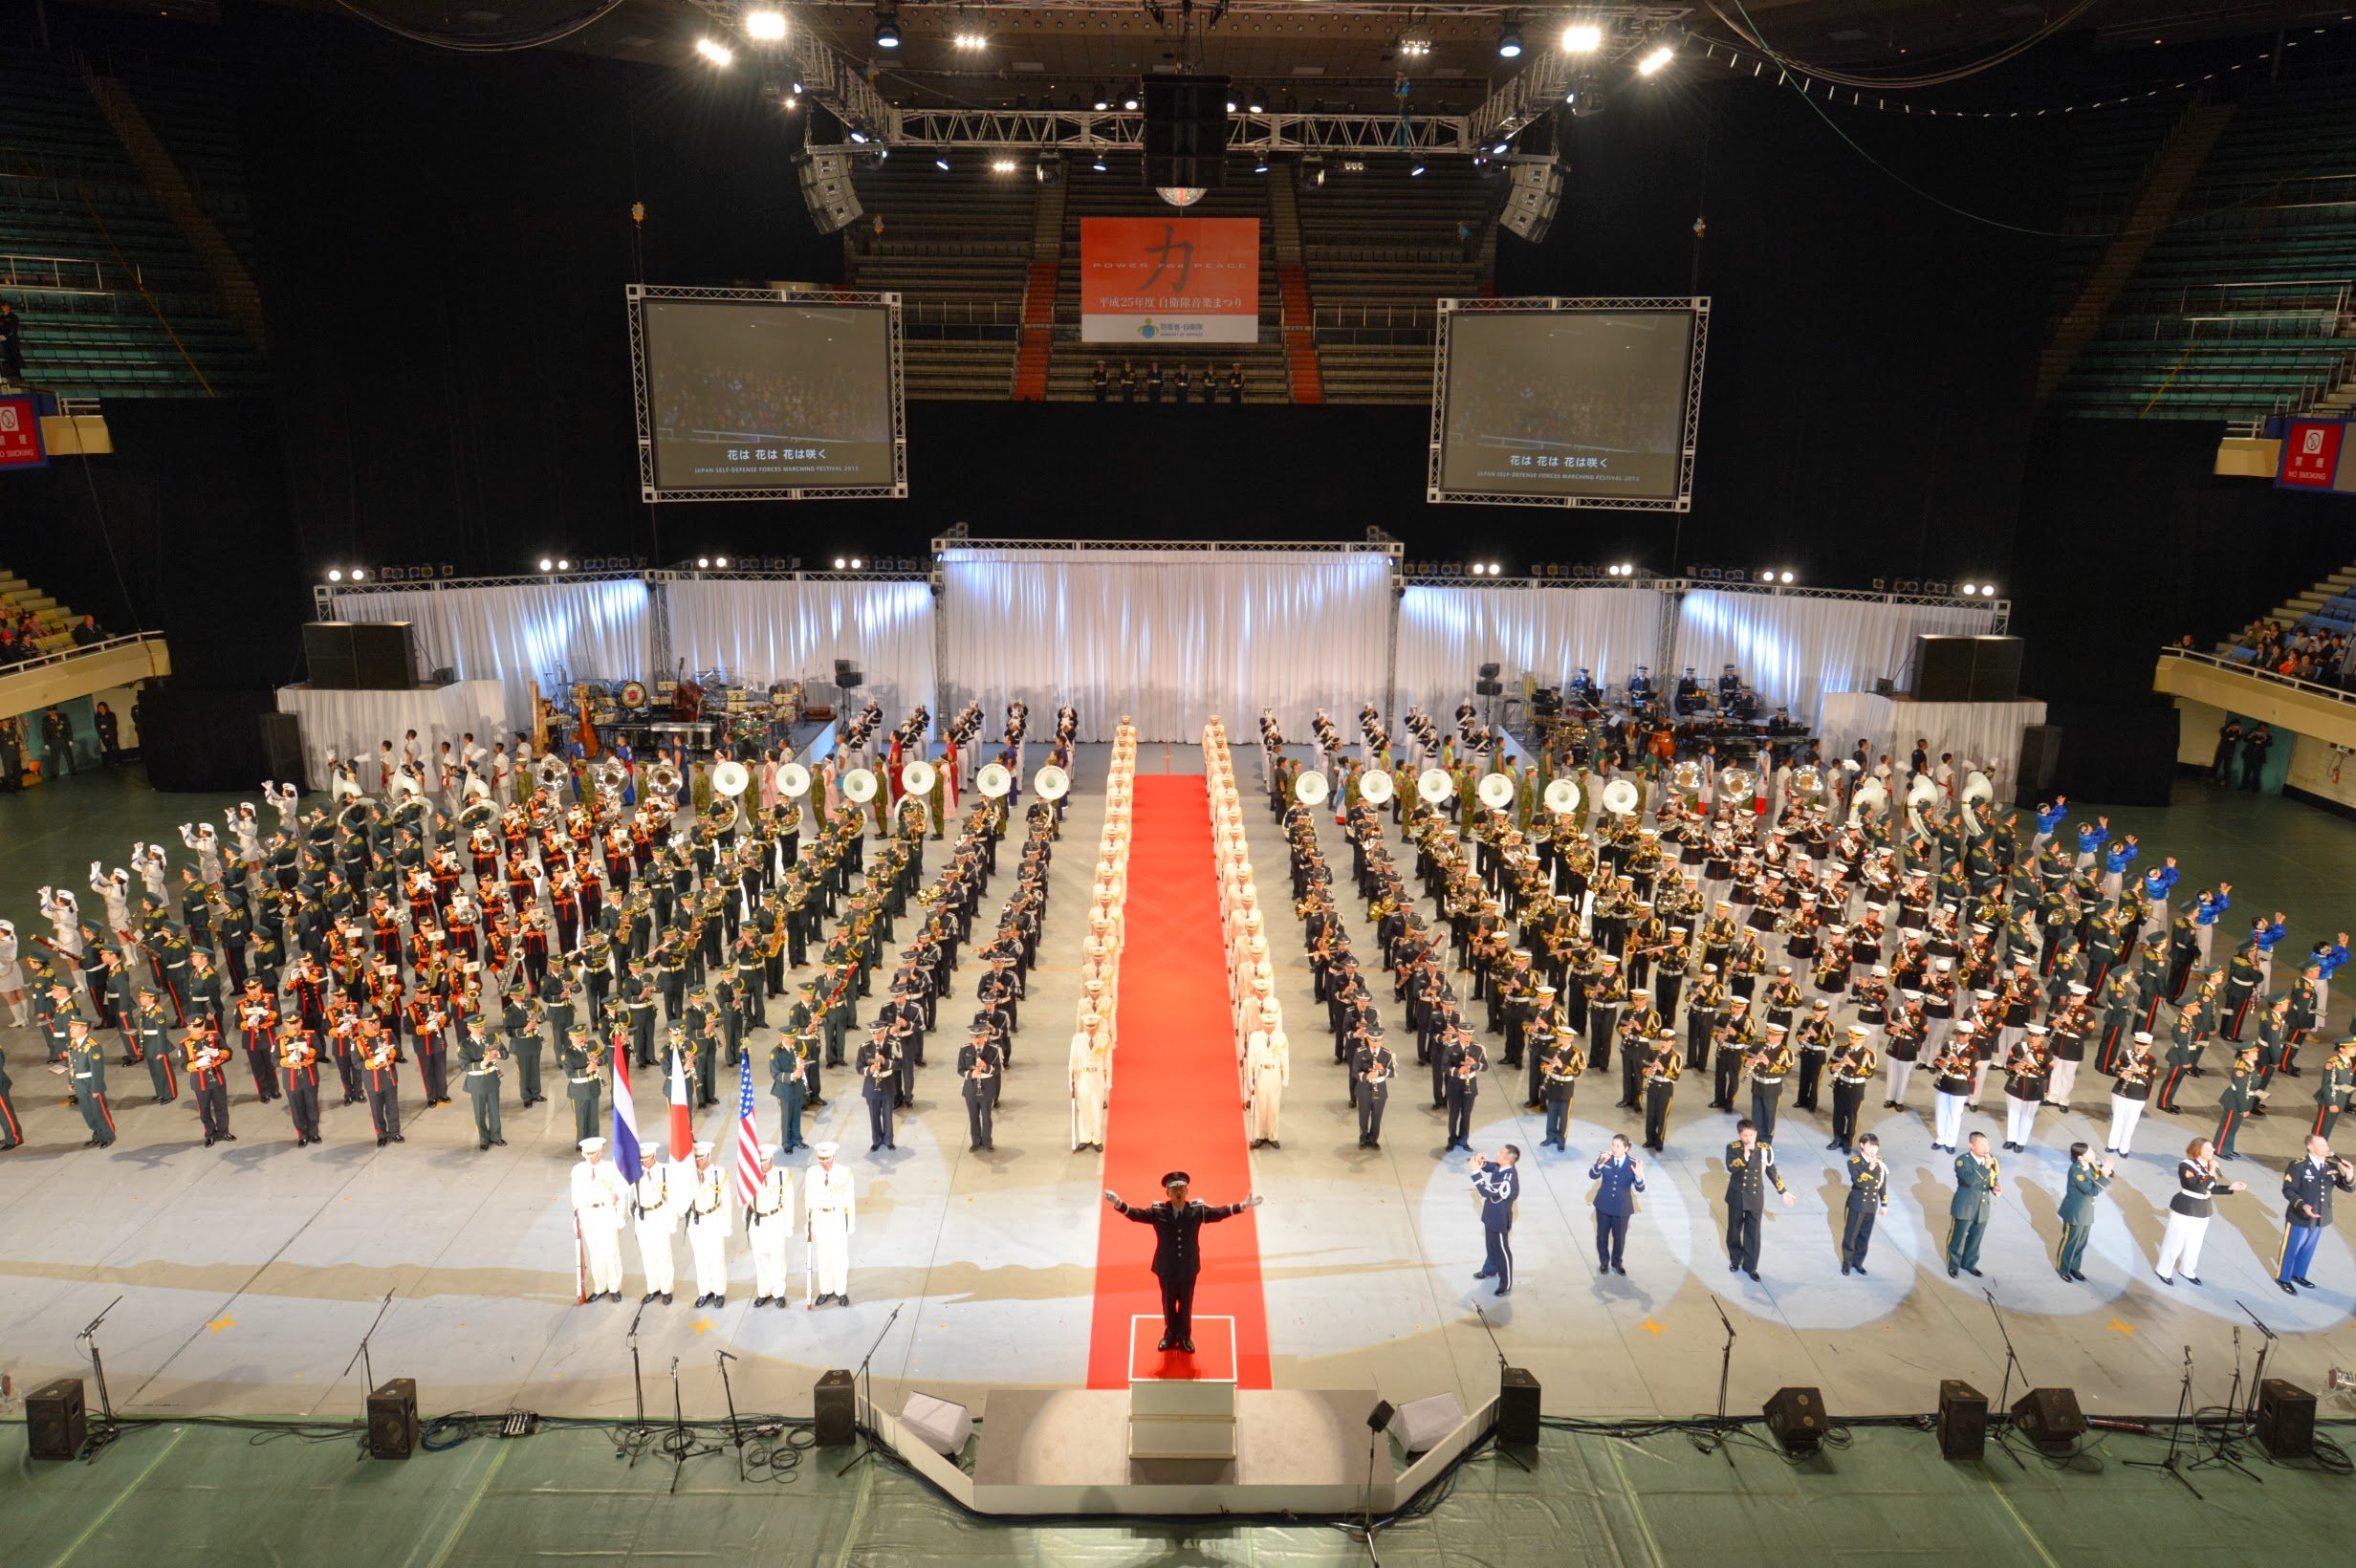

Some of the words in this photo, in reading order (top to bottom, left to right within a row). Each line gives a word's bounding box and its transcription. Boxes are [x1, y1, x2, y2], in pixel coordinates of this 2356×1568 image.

[1138, 223, 1194, 293] 力
[1101, 295, 1155, 309] 平成25年度
[1159, 295, 1242, 309] 自衛隊音楽まつり
[727, 449, 750, 461] 花は
[755, 449, 778, 460] 花は
[783, 448, 826, 460] 花は咲く
[1510, 455, 1532, 466] 花は
[1537, 456, 1559, 467] 花は
[1563, 457, 1607, 468] 花は咲く
[2298, 471, 2326, 480] SMOKING
